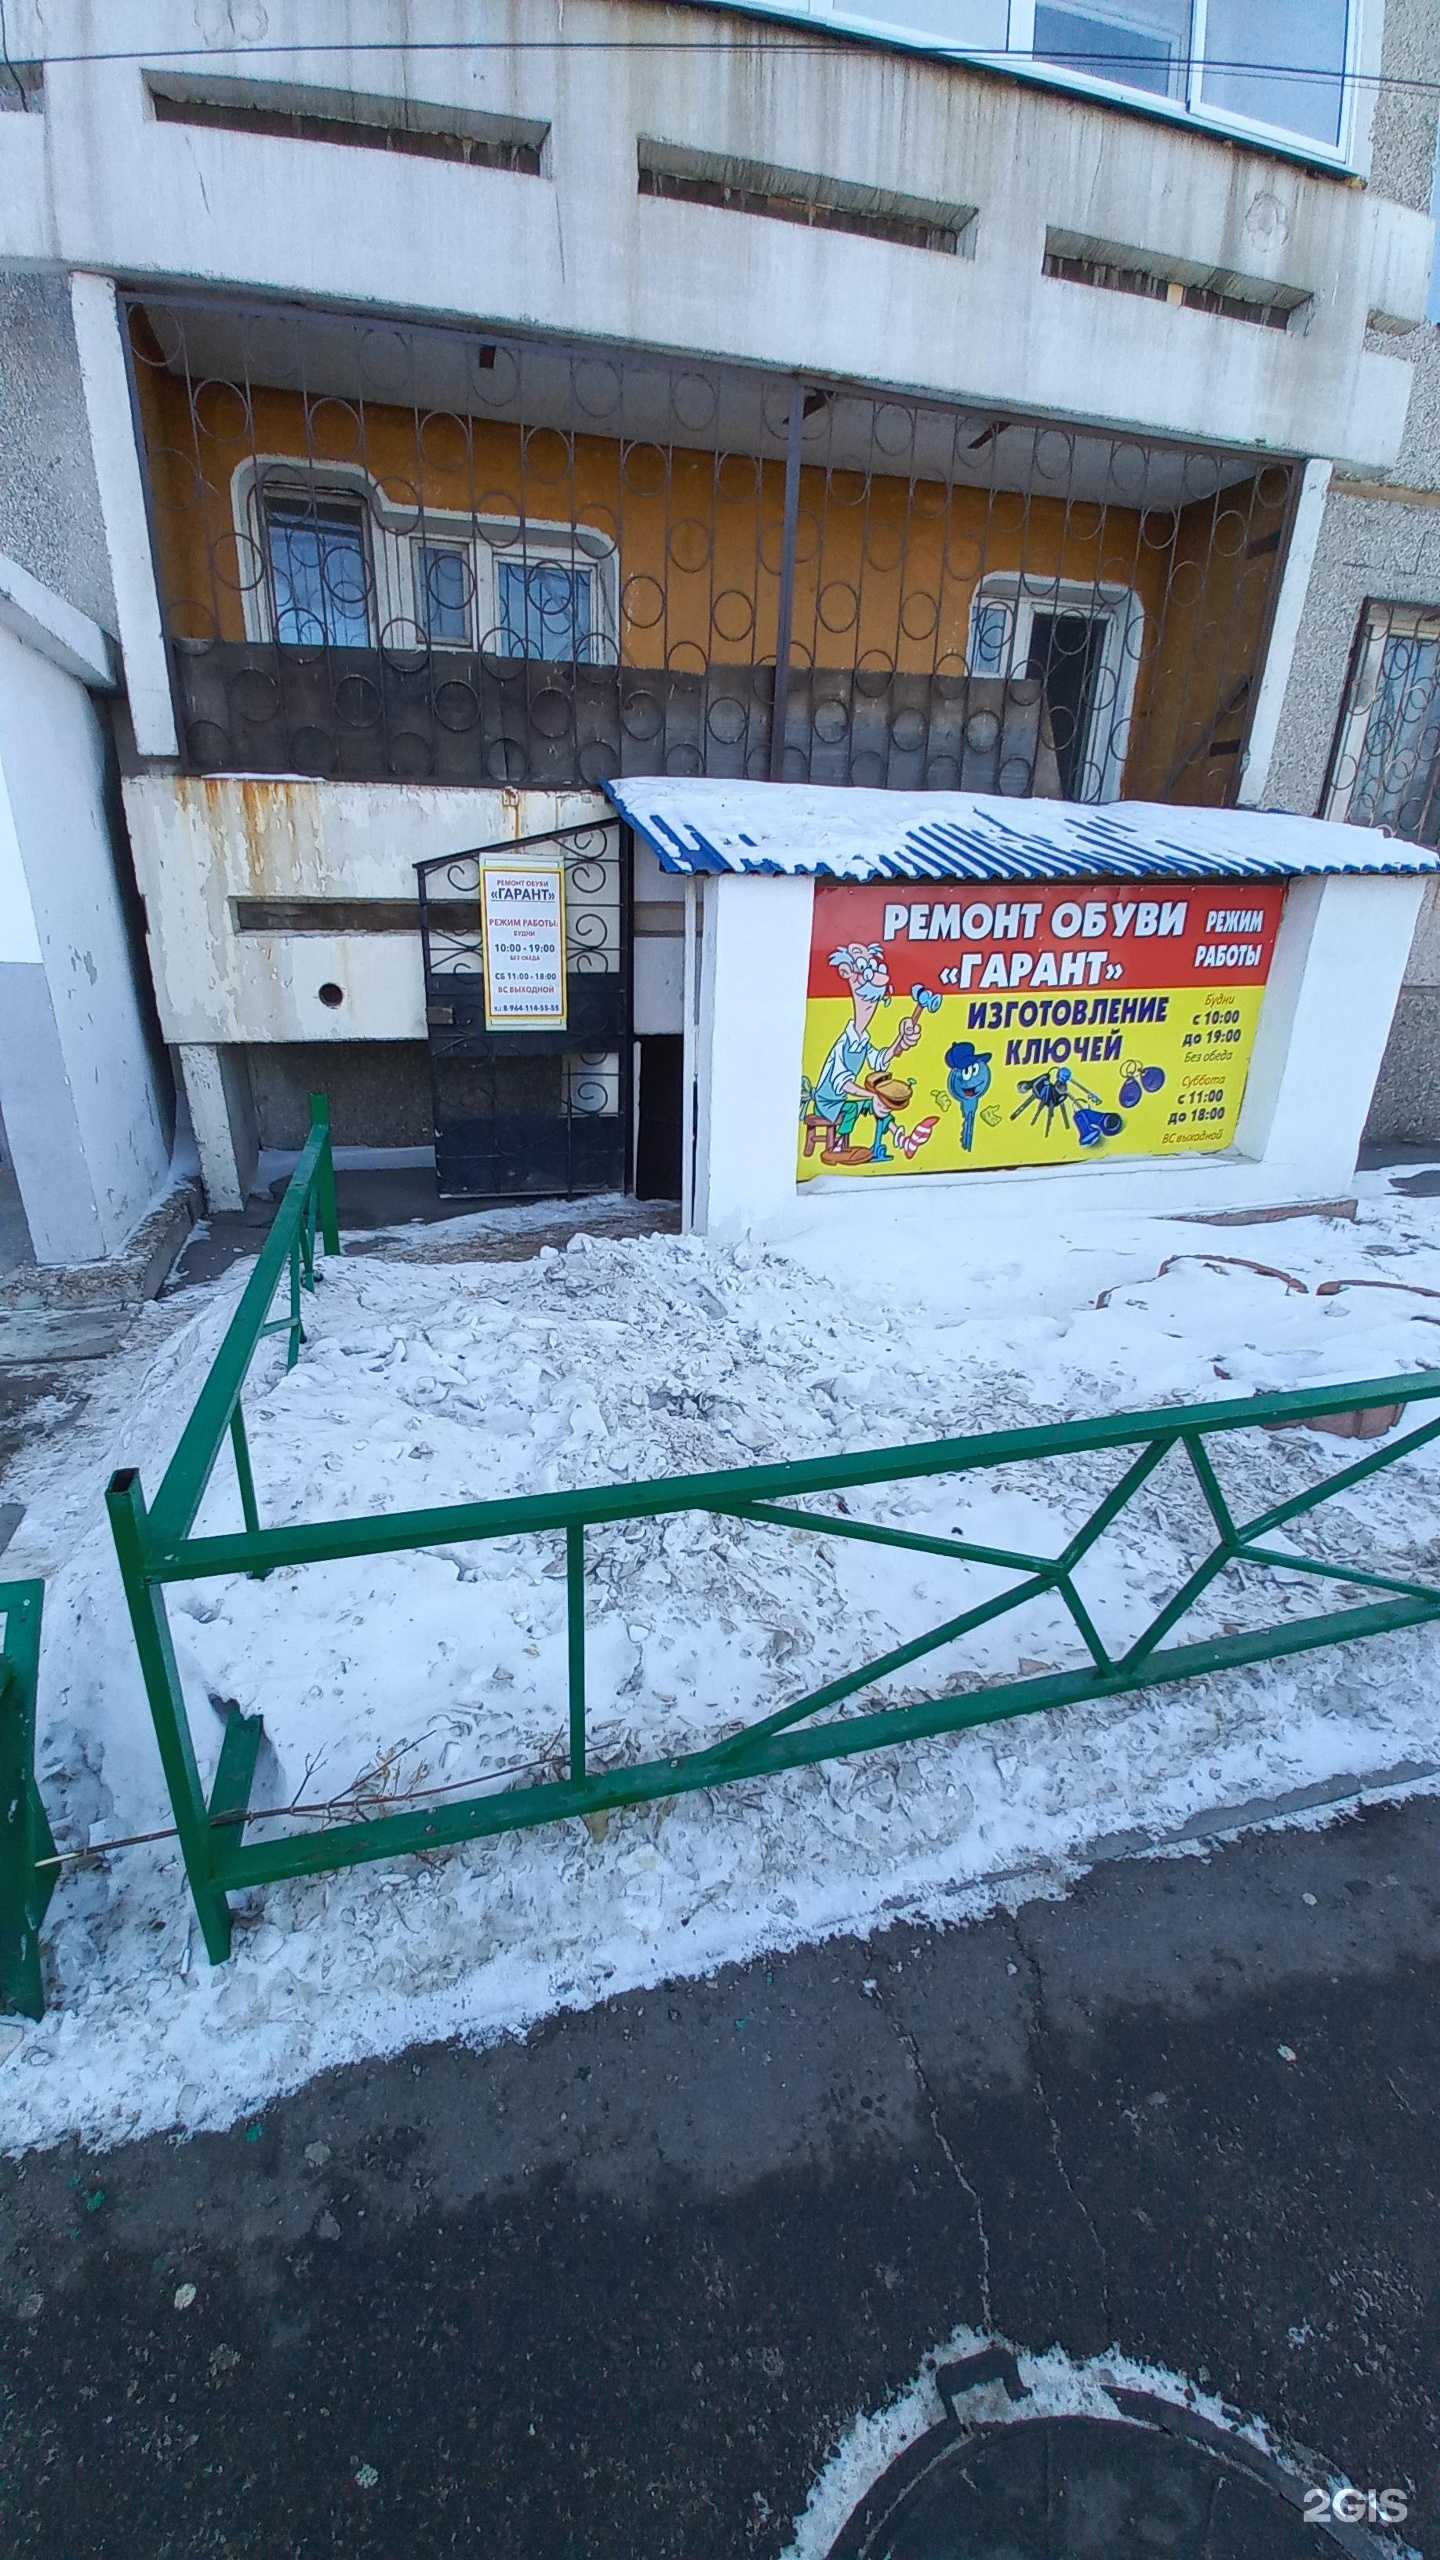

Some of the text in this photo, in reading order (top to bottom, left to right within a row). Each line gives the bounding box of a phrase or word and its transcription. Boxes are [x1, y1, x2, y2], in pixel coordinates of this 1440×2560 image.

[496, 879, 549, 888] РЕМОНТ ОБУВИ
[491, 887, 555, 901] «ГАРАНТ»
[489, 918, 521, 927] РЕЖИМ
[883, 901, 1188, 942] РЕМОНТ ОБУВИ
[1205, 909, 1264, 934] РЕЖИМ
[494, 943, 522, 953] 10:00
[529, 944, 555, 953] 19:00
[1194, 944, 1260, 968] РАБОТЫ
[939, 951, 1125, 990] «ГАРАНТ»
[509, 985, 555, 994] ВЫХОДНОЙ
[1204, 994, 1235, 1007] Будни
[967, 996, 1169, 1029] ИЗГОТОВЛЕНИЕ
[1204, 1010, 1240, 1025] 10:00
[1182, 1029, 1241, 1048] до 19:00
[1004, 1029, 1123, 1066] КЛЮЧЕЙ
[1184, 1050, 1233, 1063] Без обеда
[1181, 1074, 1226, 1088] Суббота
[1188, 1089, 1223, 1104] 11:00
[1168, 1107, 1225, 1125] до 18:00
[1176, 1129, 1223, 1143] выходной
